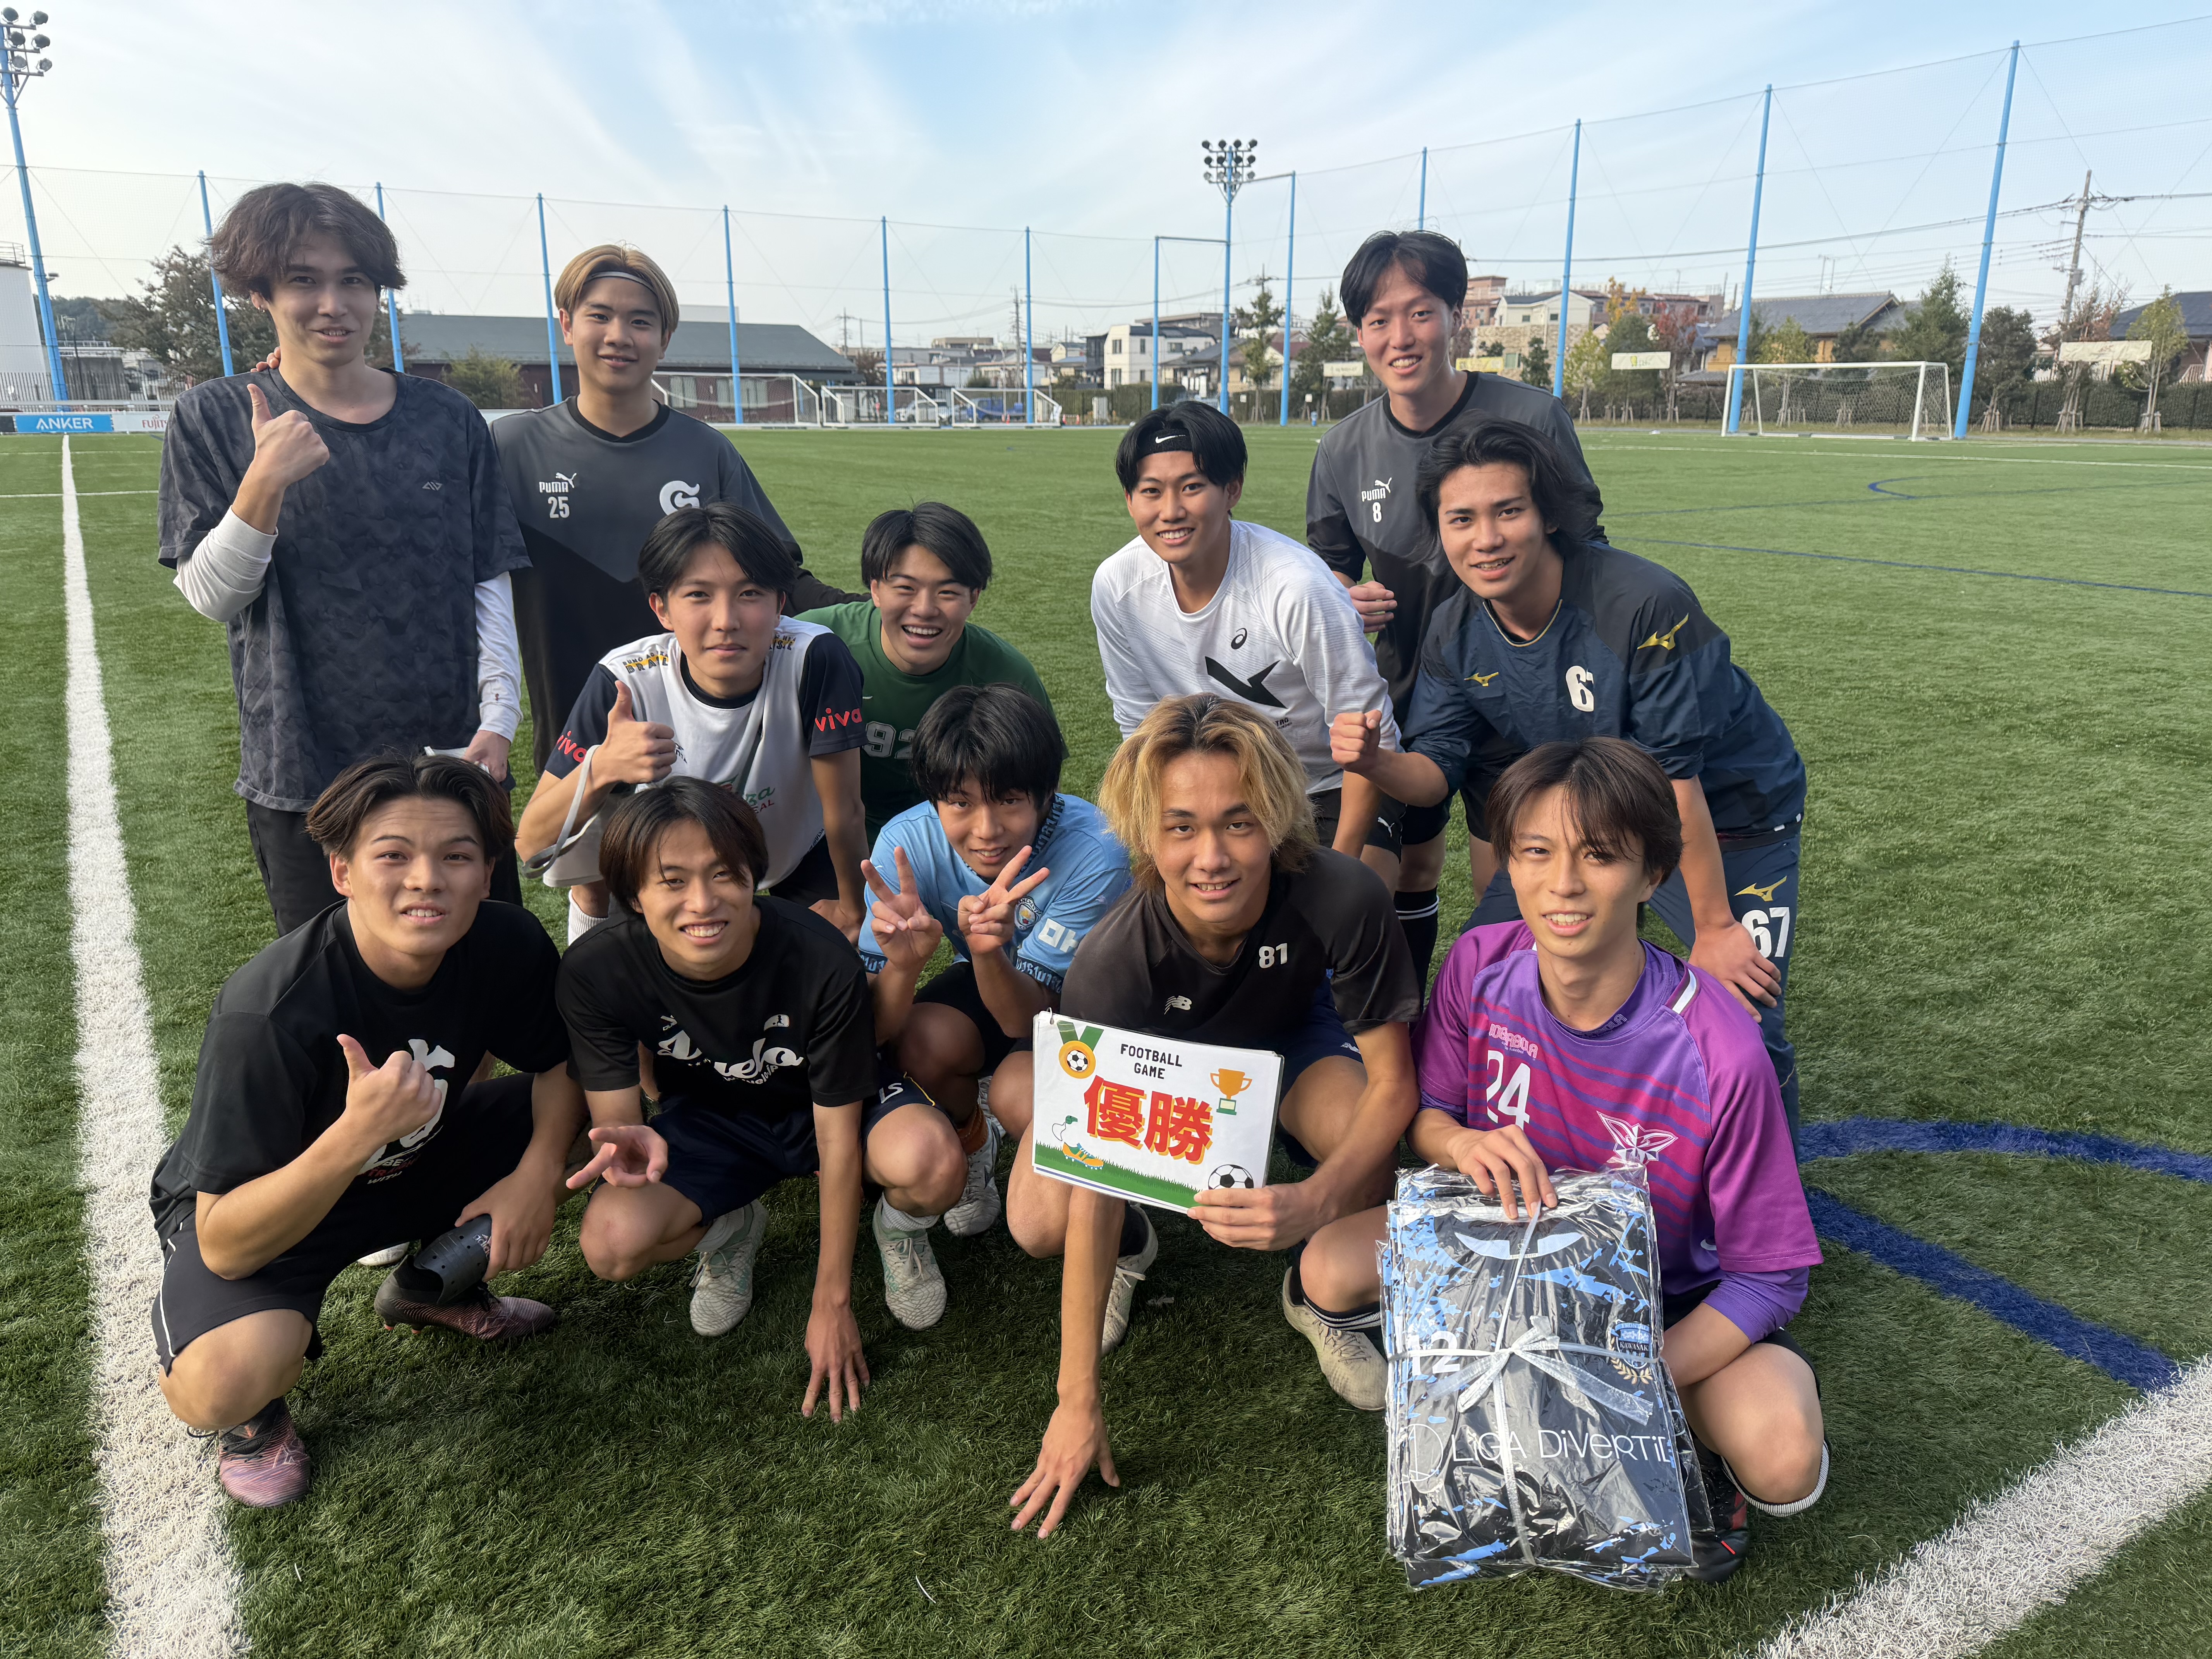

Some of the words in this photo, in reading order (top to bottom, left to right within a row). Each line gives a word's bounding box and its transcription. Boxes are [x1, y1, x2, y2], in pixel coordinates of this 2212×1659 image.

[36, 417, 94, 430] ANKER
[539, 481, 568, 493] PUMA
[1361, 488, 1386, 502] PUMA
[548, 496, 570, 519] 25
[1372, 502, 1382, 522] 8
[815, 708, 862, 732] viva
[1741, 907, 1790, 958] 67
[1259, 943, 1288, 968] 81
[1121, 1043, 1182, 1067] FOOTBALL
[1134, 1062, 1165, 1079] GAME
[1084, 1074, 1214, 1165] 優勝
